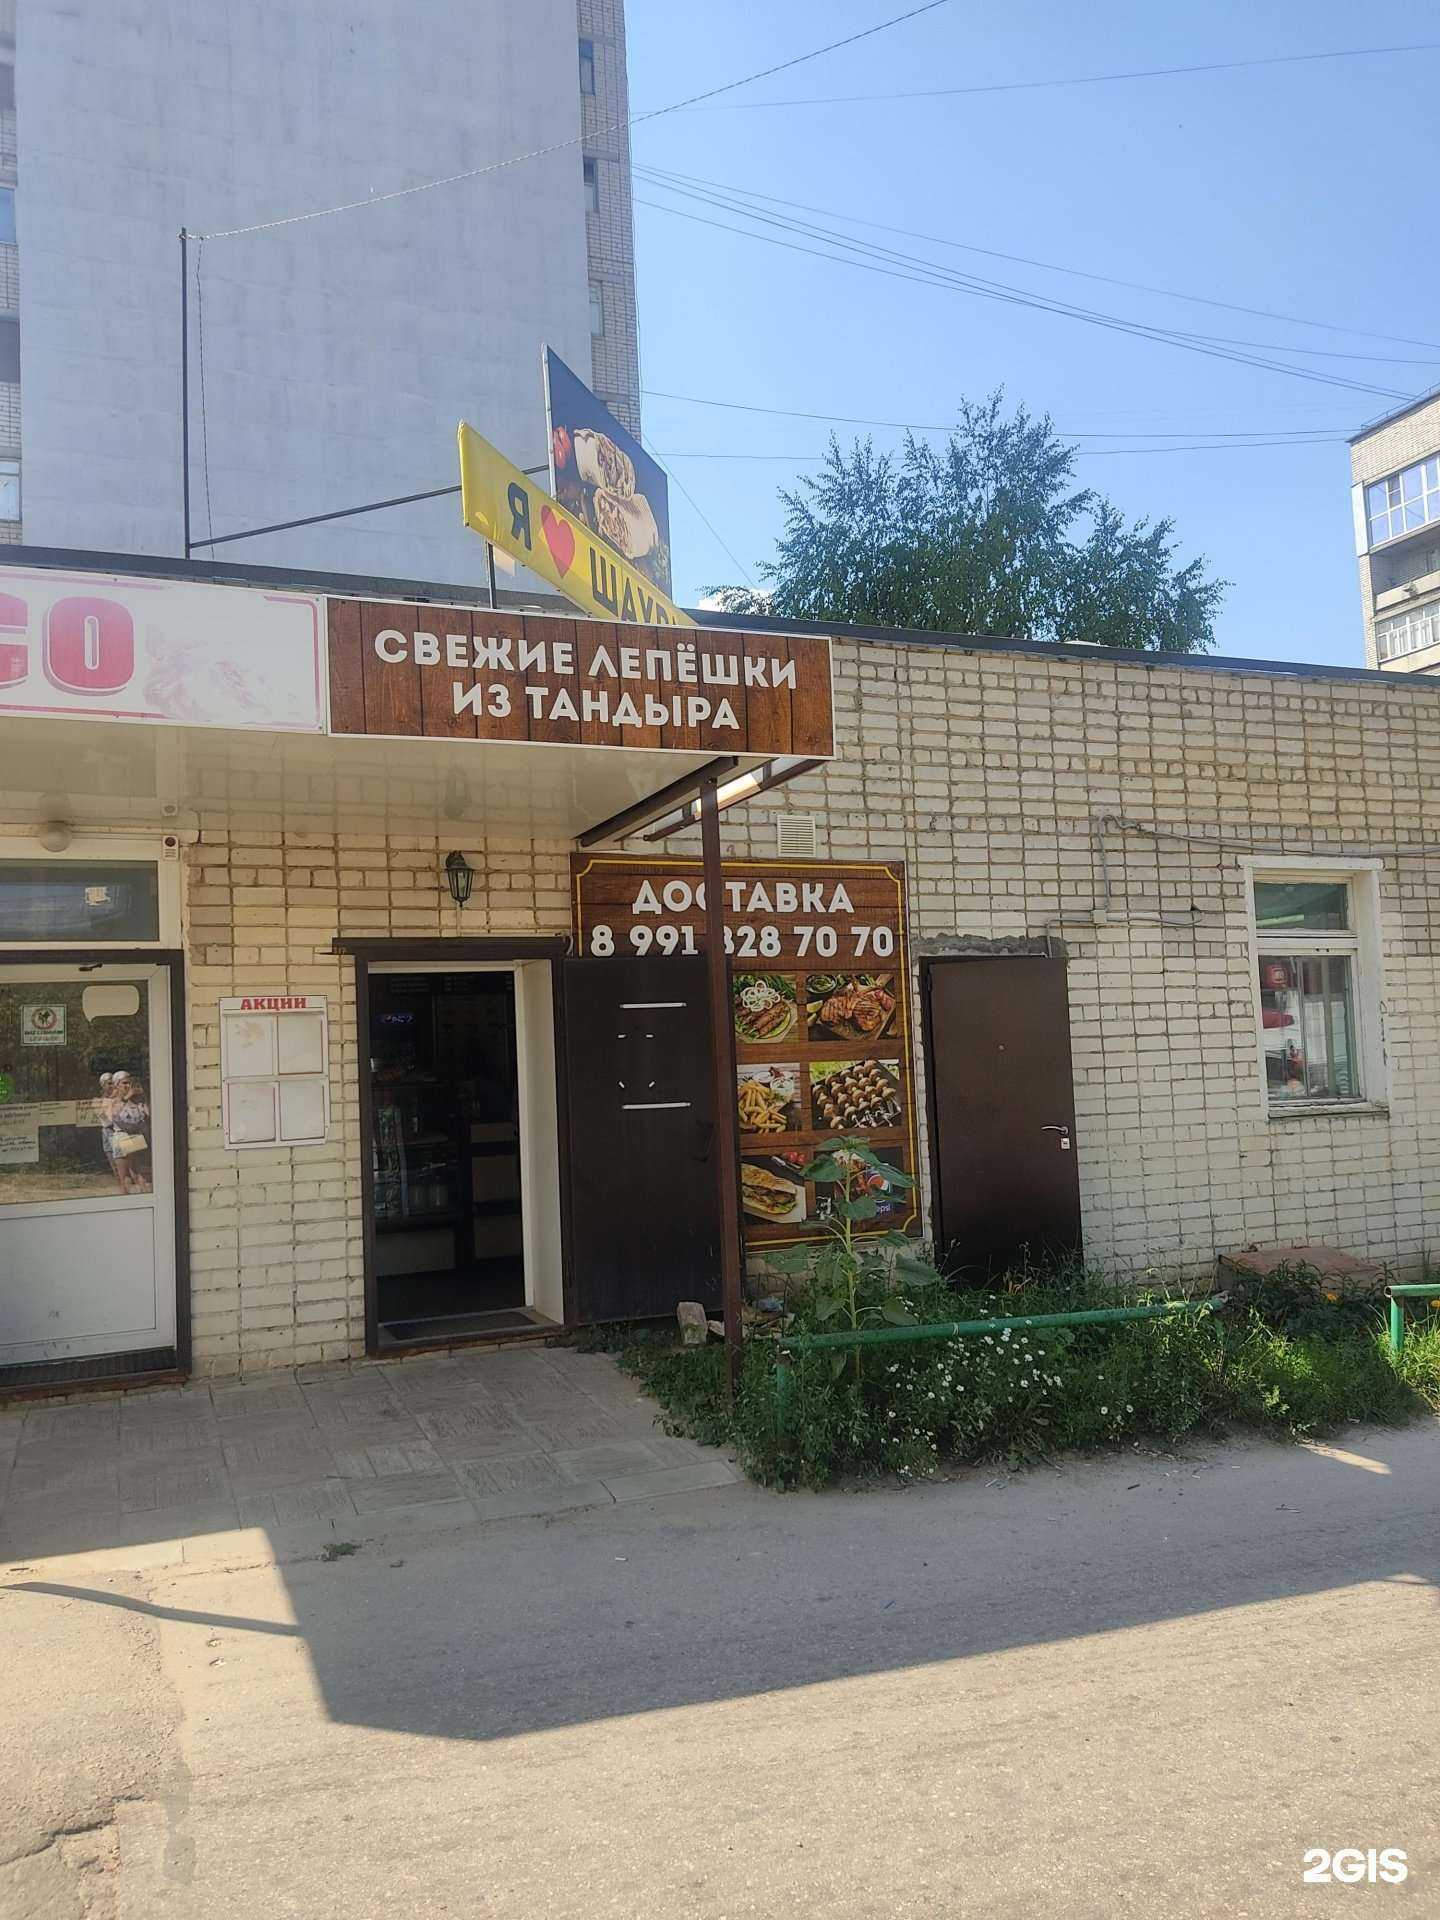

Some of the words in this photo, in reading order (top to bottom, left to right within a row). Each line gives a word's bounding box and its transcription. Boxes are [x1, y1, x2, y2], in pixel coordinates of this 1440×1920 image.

[508, 482, 532, 551] Я
[374, 629, 575, 675] СВЕЖИЕ
[588, 642, 797, 690] ЛЕПЁШКИ
[452, 681, 512, 718] ИЗ
[526, 686, 740, 730] ТАНДЫРА
[591, 924, 615, 957] 8
[629, 924, 699, 956] 991
[793, 925, 837, 958] 70
[851, 926, 894, 958] 70
[240, 997, 308, 1011] АКЦИИ
